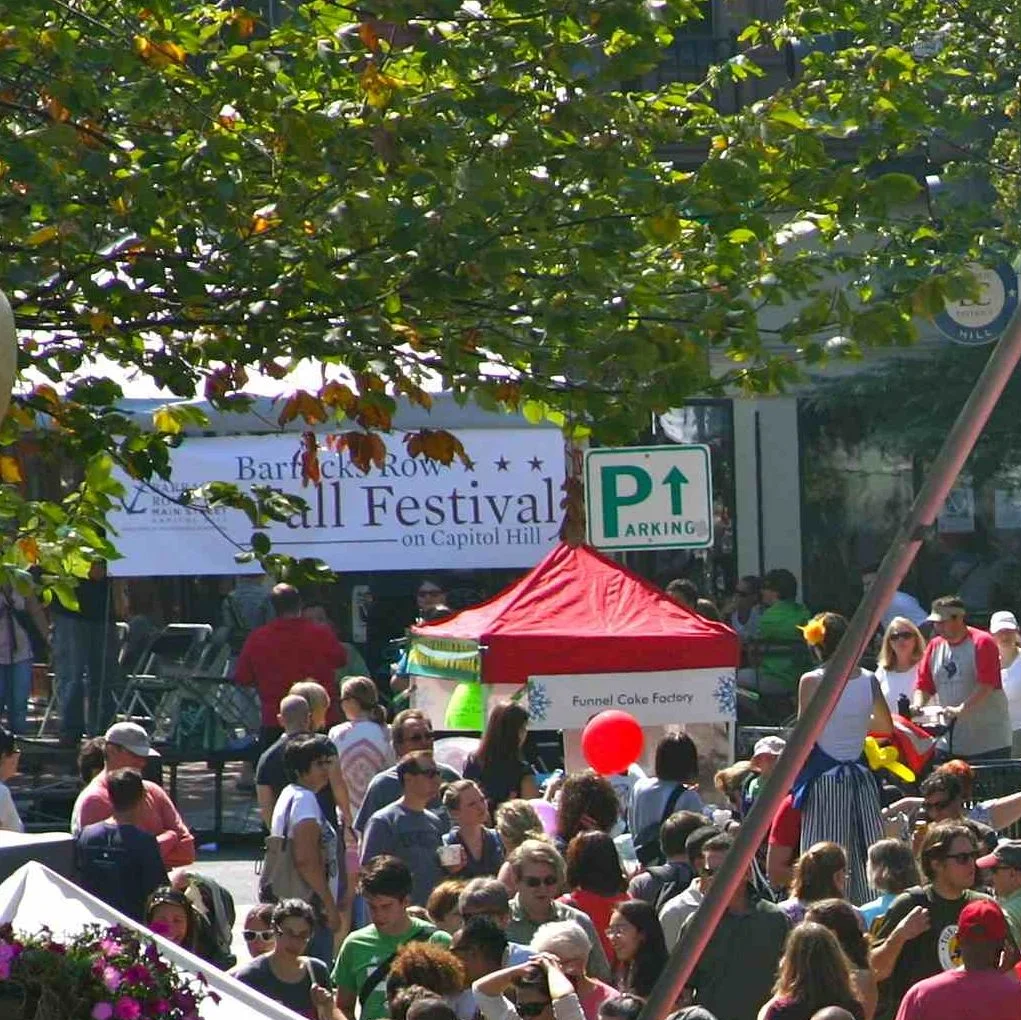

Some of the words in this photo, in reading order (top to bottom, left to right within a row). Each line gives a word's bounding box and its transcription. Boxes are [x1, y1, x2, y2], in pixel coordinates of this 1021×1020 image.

[236, 450, 366, 481] Barrcks
[380, 453, 443, 478] Row
[359, 477, 557, 528] Festival
[402, 532, 425, 547] on
[430, 528, 500, 549] Capitol
[506, 526, 541, 546] Hill
[572, 695, 613, 707] Funnel
[617, 693, 649, 705] Cake
[652, 692, 693, 704] Factory
